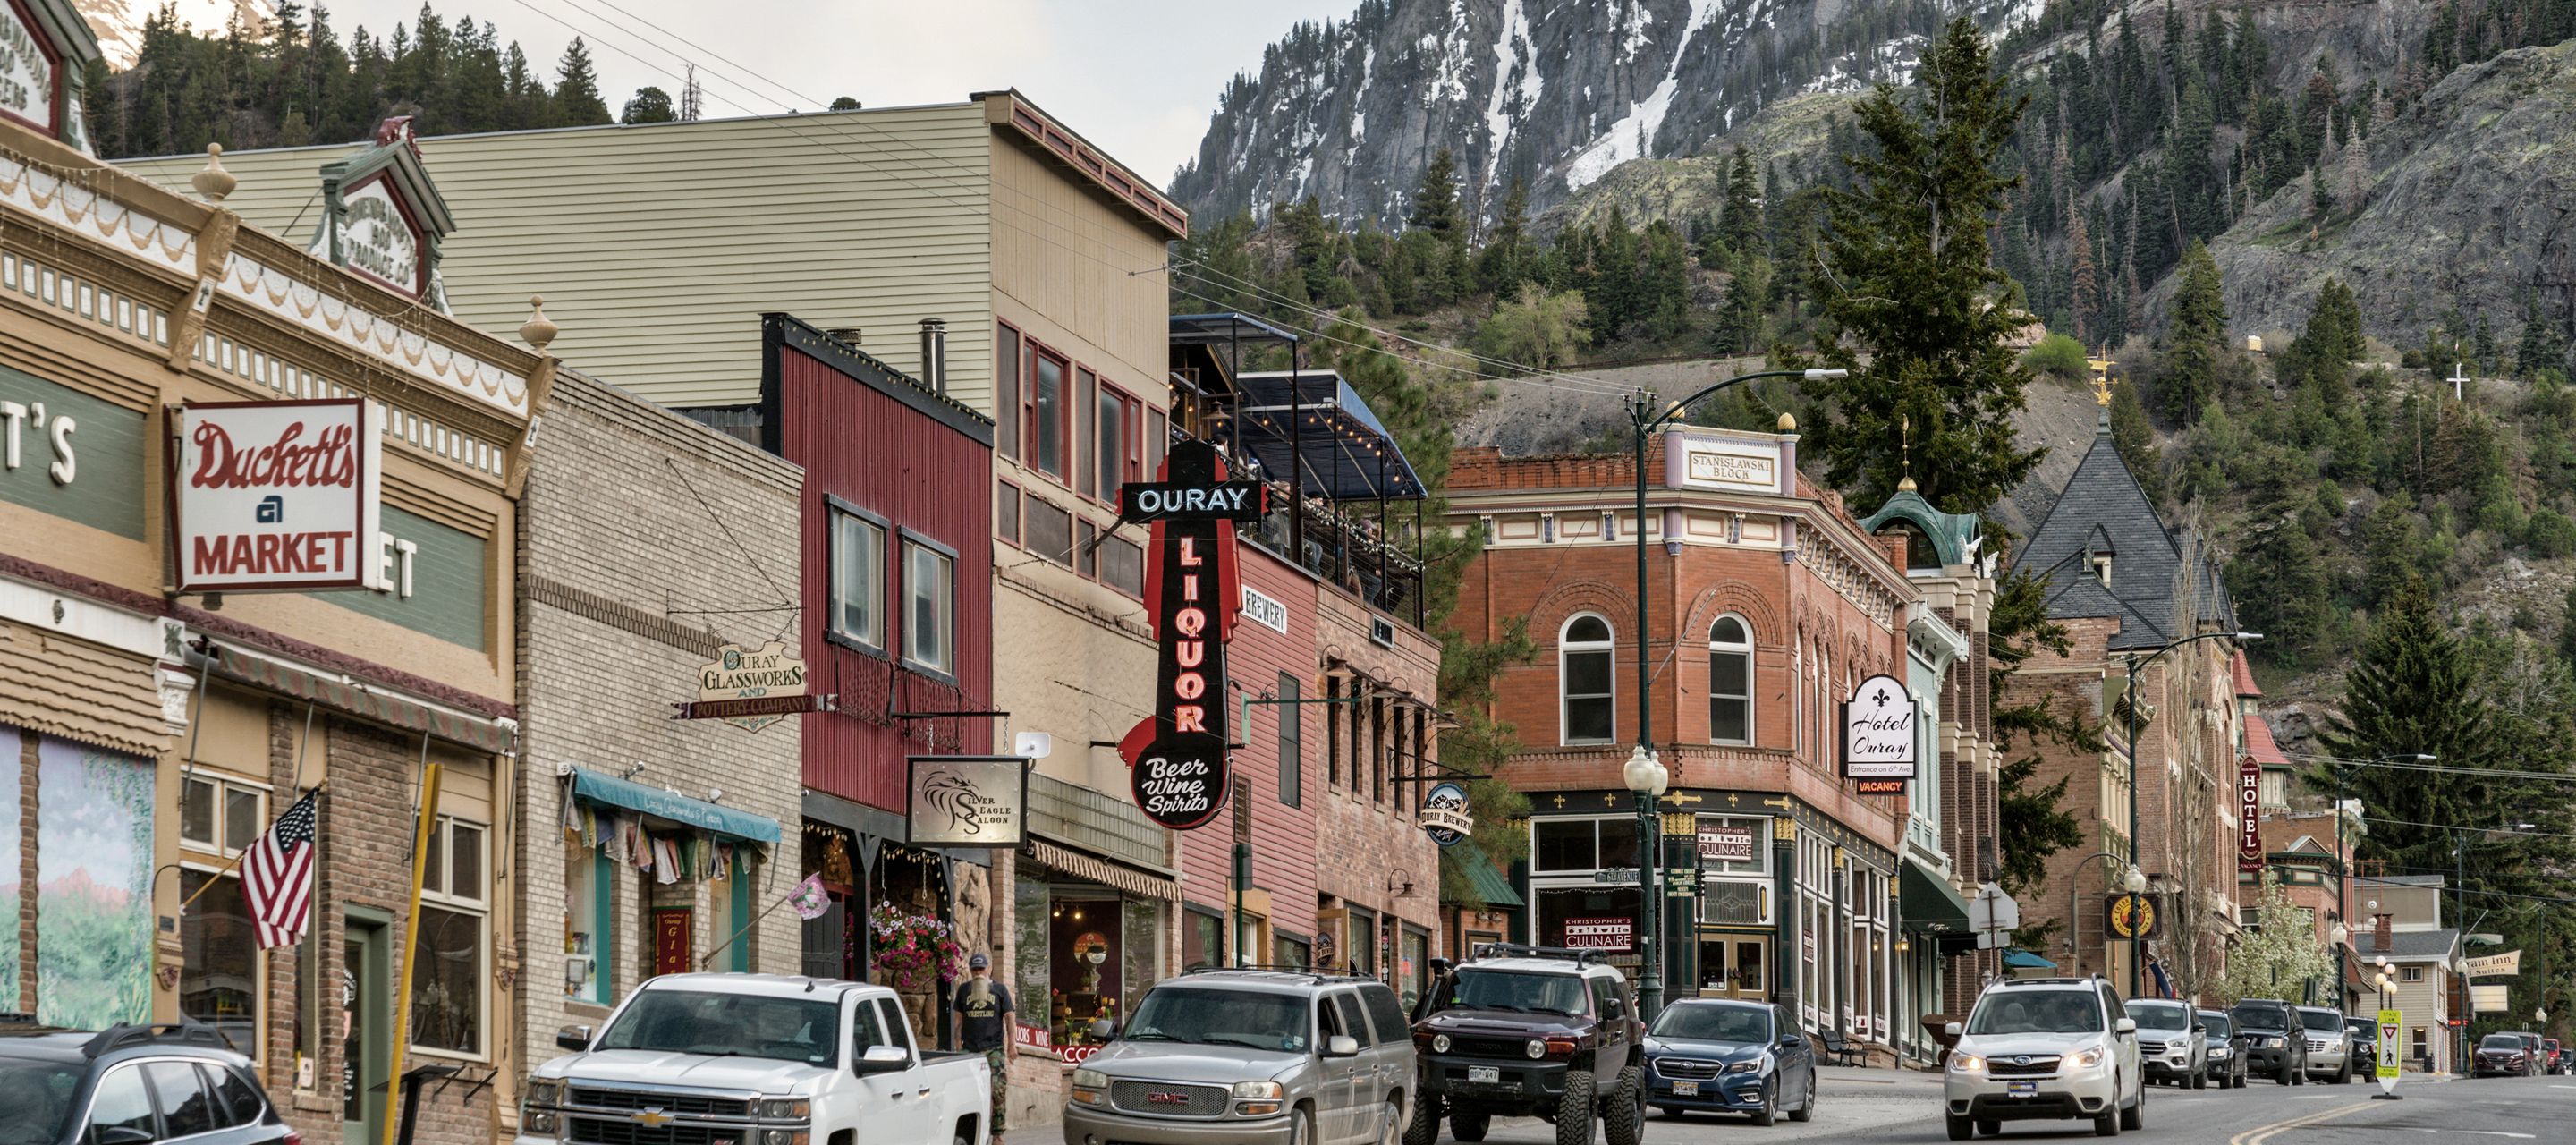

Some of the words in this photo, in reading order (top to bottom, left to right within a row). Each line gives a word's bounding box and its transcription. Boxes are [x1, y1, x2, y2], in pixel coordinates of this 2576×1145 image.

[343, 237, 394, 278] PRODUCE
[1, 400, 76, 485] T'S
[191, 420, 354, 489] Duckett's
[1692, 455, 1770, 471] STANISLAWSKI
[1714, 467, 1750, 479] BLOCK
[1138, 488, 1248, 513] OURAY
[194, 531, 352, 575] MARKET
[378, 531, 418, 598] ET
[1246, 589, 1284, 631] BREWERY
[1175, 537, 1207, 733] LIQUOR
[704, 666, 802, 691] GLASSWORKS
[737, 687, 767, 698] AND
[696, 701, 749, 715] POTTERY
[750, 697, 809, 714] COMPANY
[1852, 709, 1911, 734] Hotel
[1853, 735, 1909, 759] Ouray
[1146, 758, 1208, 778] Beer
[1141, 777, 1205, 795] Wine
[1859, 782, 1902, 792] VACANCY
[1146, 793, 1208, 816] Spirits
[2243, 775, 2257, 847] HOTEL
[1444, 812, 1471, 831] BREWERY
[1698, 827, 1752, 835] KHRISTOPHER'S
[1698, 843, 1752, 856] CULINAIRE
[1617, 872, 1638, 882] AVENUE
[1566, 935, 1631, 946] CULINAIRE
[2466, 959, 2488, 968] ram
[1015, 1026, 1030, 1044] UORS
[1035, 1030, 1049, 1047] WINE
[1055, 1047, 1099, 1063] ACCO
[1147, 1092, 1189, 1105] GMC
